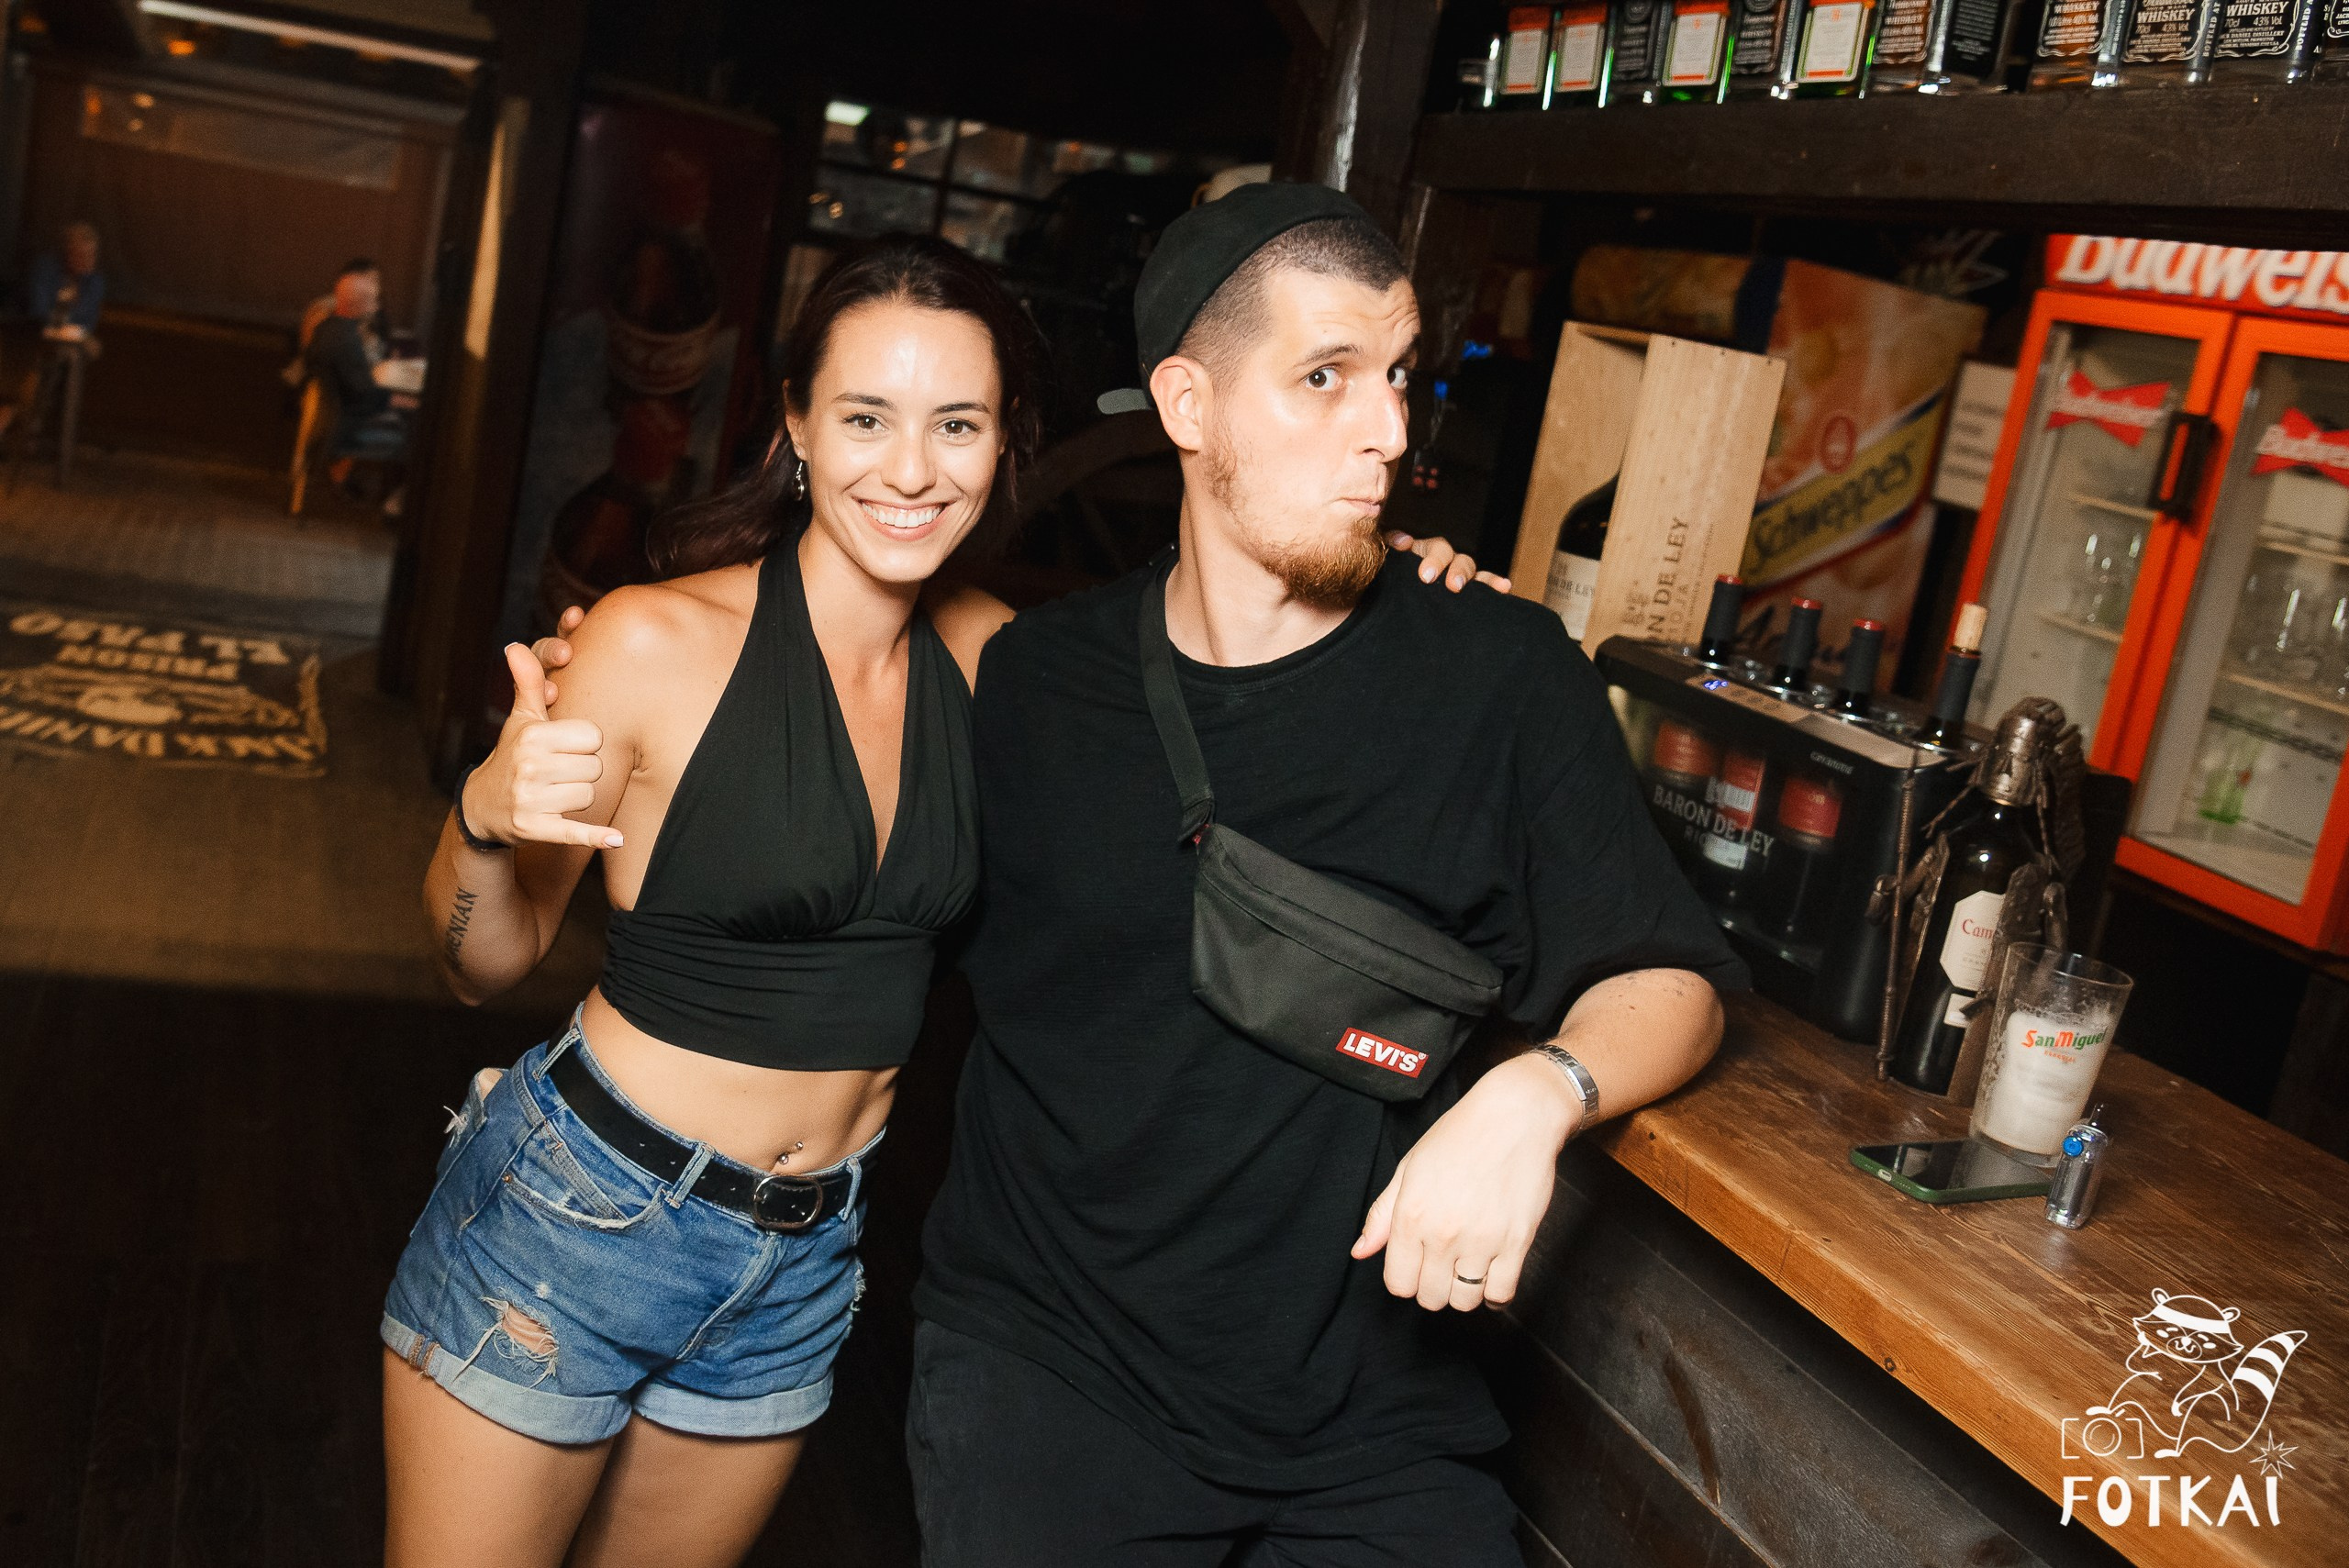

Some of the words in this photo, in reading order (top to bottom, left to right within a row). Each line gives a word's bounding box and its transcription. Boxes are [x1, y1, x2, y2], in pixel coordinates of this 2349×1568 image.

[2137, 8, 2195, 24] WHISKEY
[2227, 1, 2289, 17] WHISKEY
[1662, 517, 1690, 564] LEY
[1652, 573, 1677, 606] DE
[1653, 784, 1712, 828] BARON
[1712, 813, 1737, 841] DE
